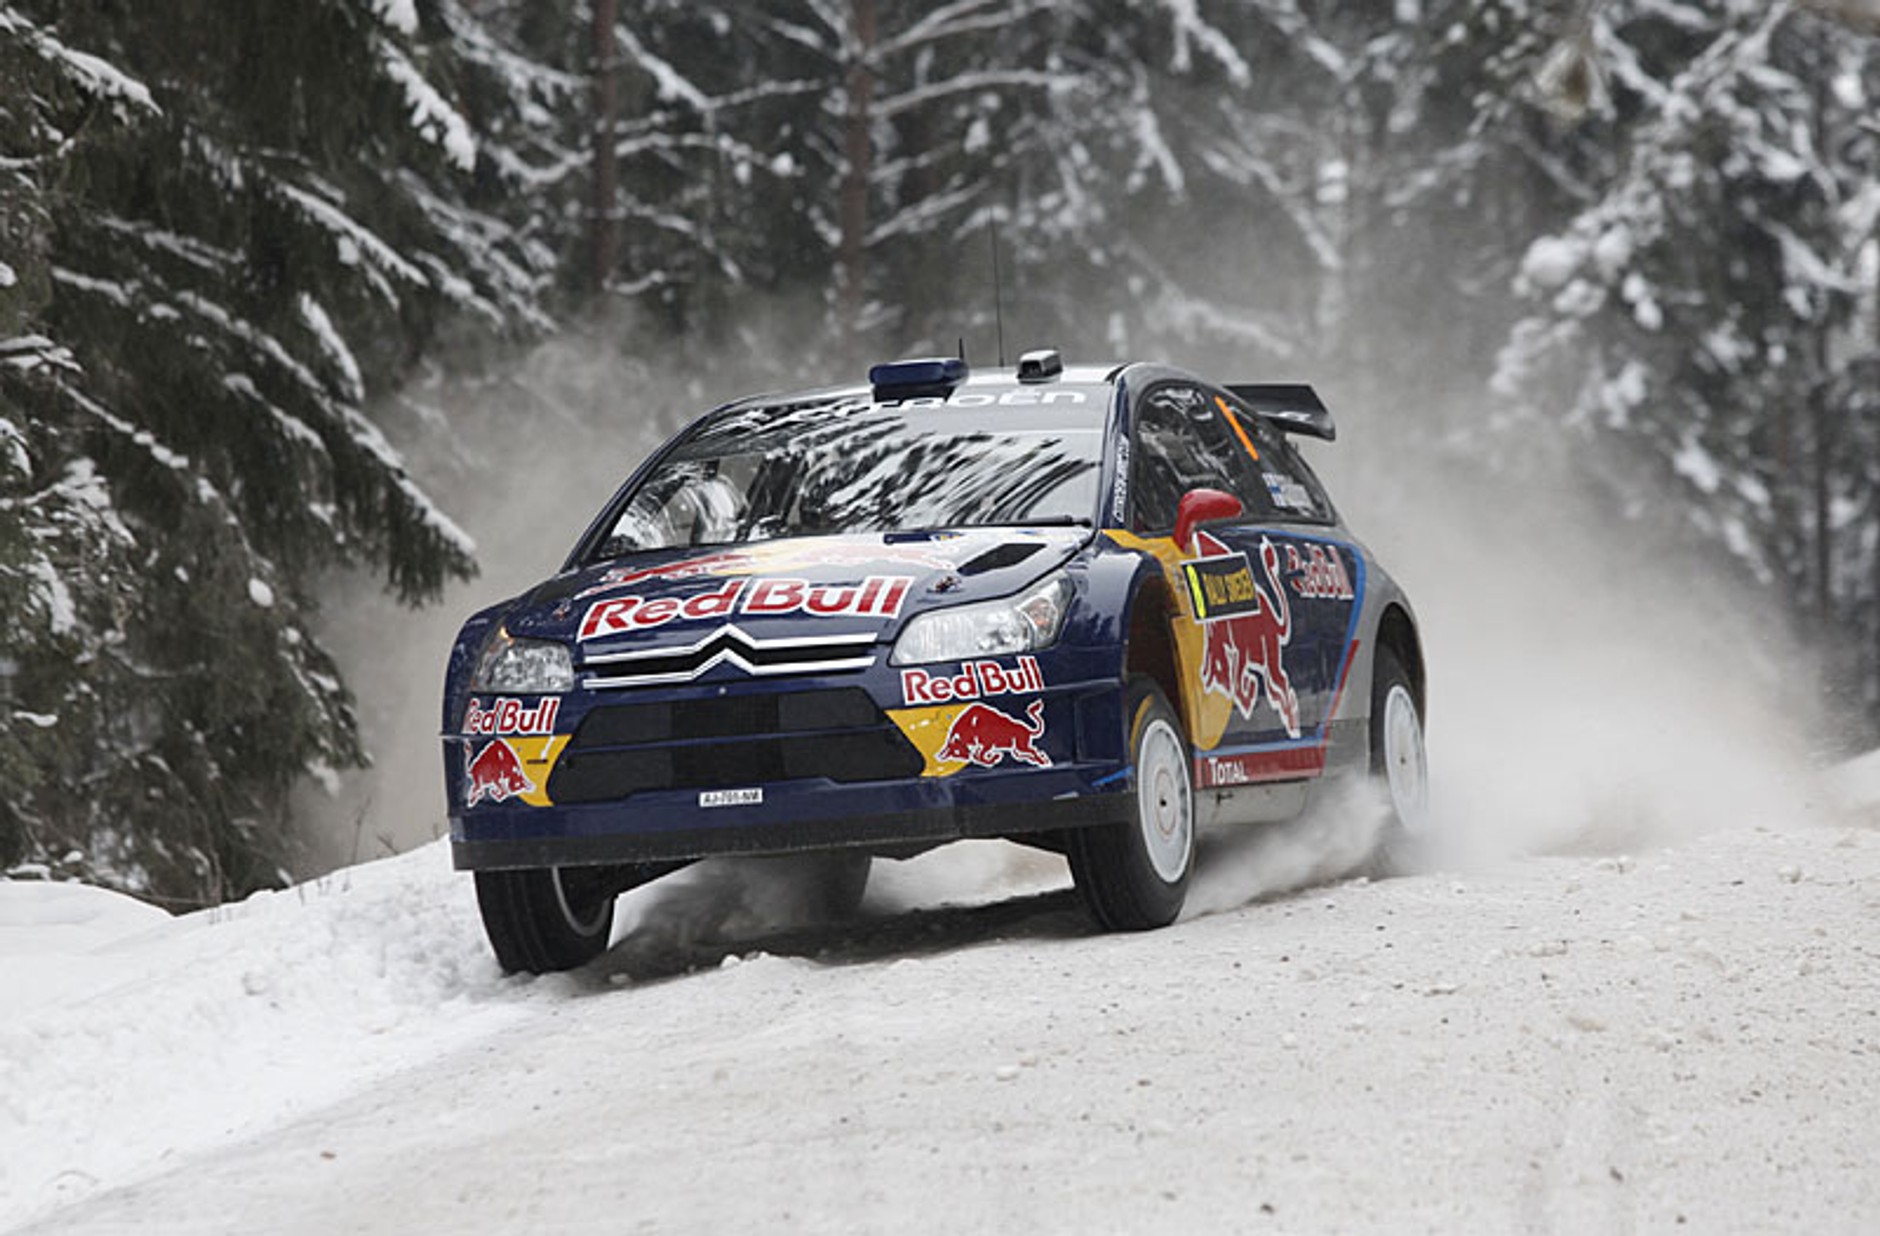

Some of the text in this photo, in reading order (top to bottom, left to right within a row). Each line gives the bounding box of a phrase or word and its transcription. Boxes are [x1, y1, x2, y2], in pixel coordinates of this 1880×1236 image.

[577, 576, 914, 641] Red Bull
[902, 656, 1044, 704] Red Bull
[496, 697, 560, 734] Bull
